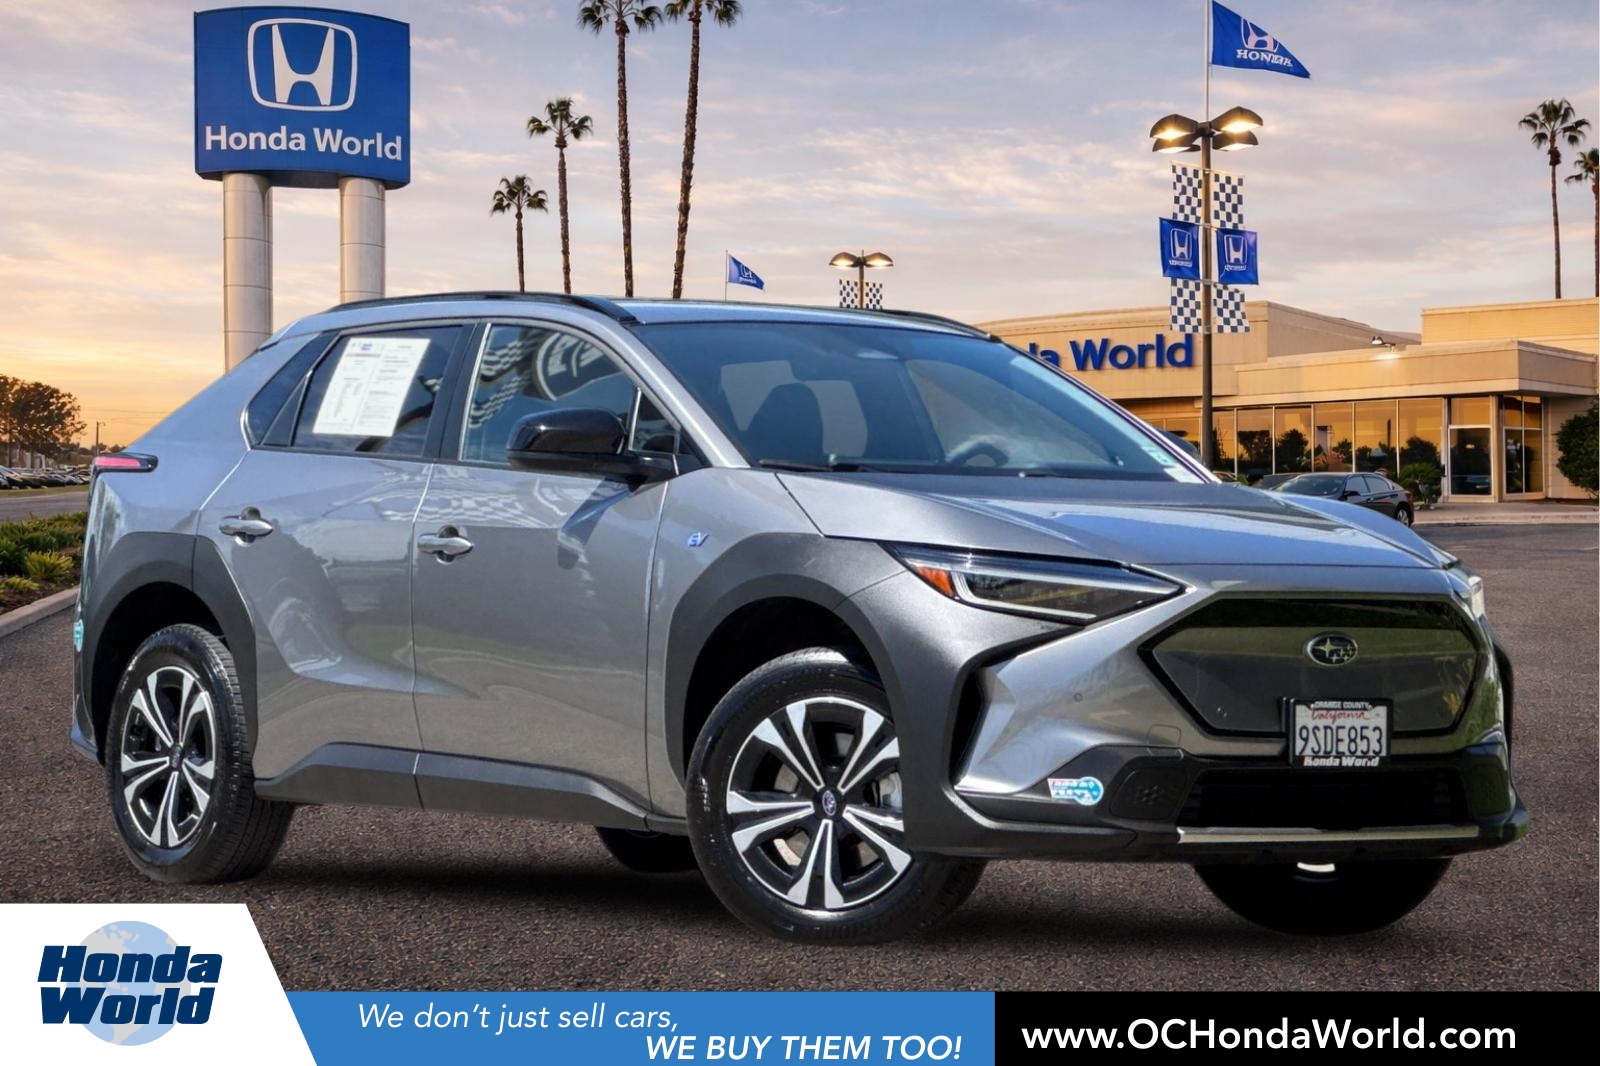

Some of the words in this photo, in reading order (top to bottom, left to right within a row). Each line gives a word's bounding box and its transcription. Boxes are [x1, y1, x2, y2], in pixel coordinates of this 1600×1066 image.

[205, 125, 306, 151] Honda
[312, 127, 402, 161] World
[1069, 333, 1194, 372] World
[1311, 709, 1369, 724] California
[1299, 725, 1383, 756] 9SDE853
[1303, 756, 1340, 767] Honda
[1341, 756, 1380, 767] World
